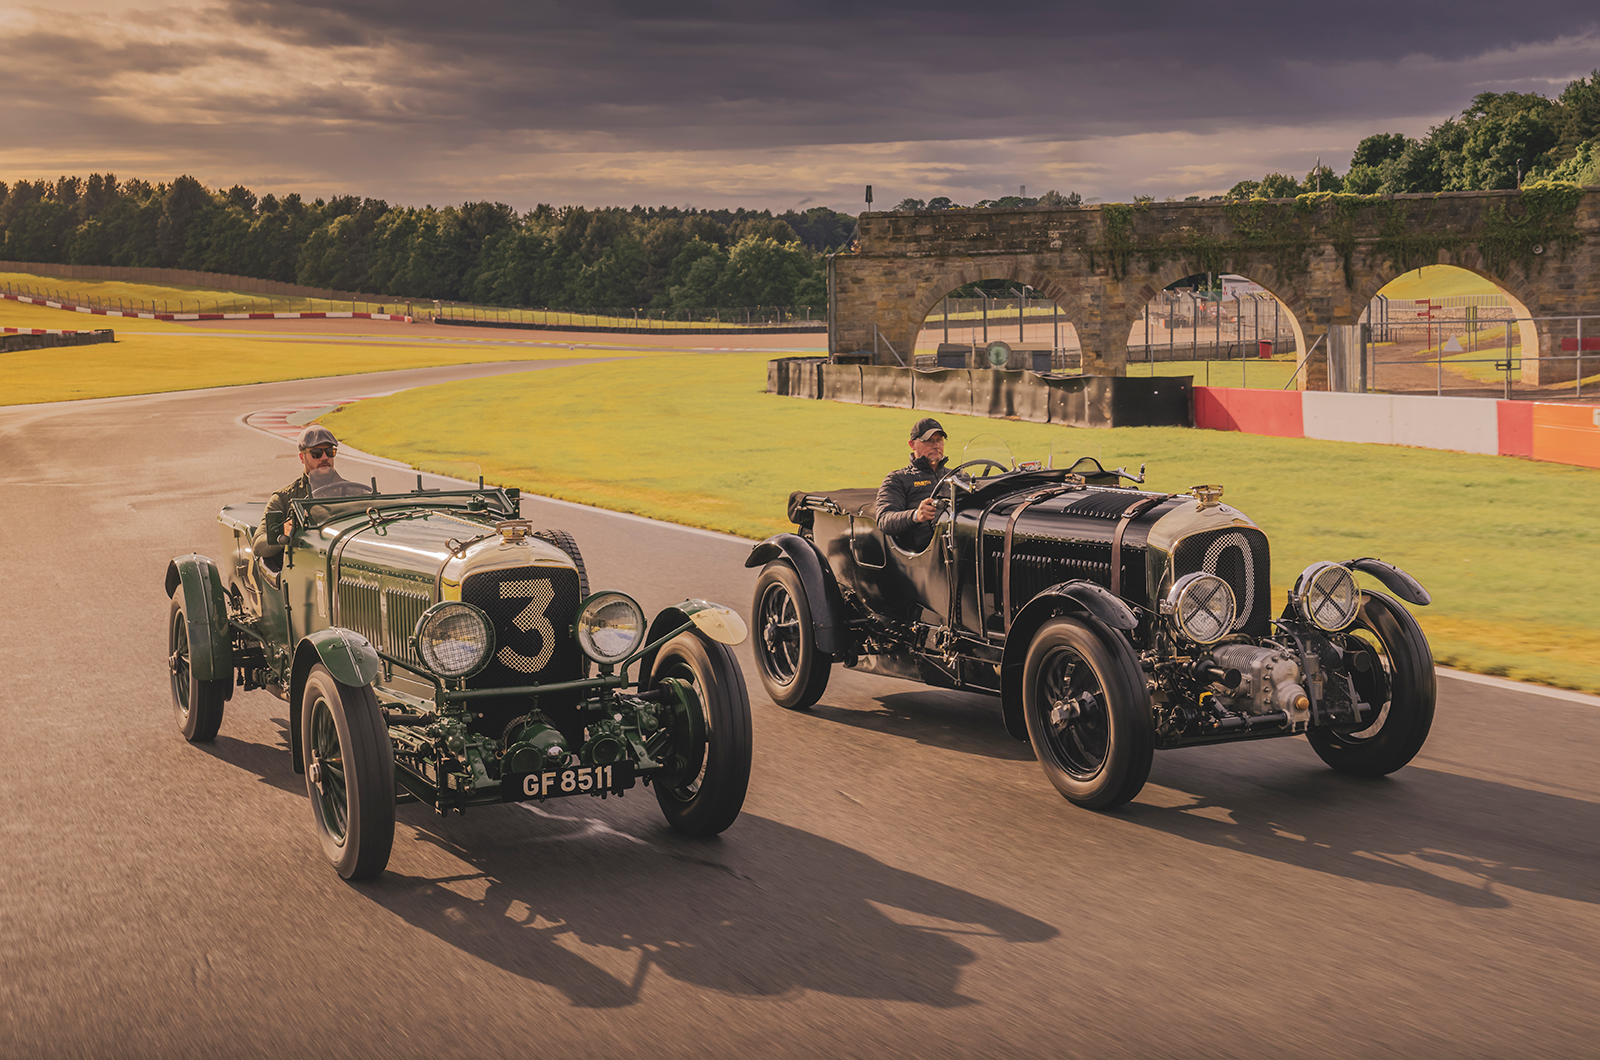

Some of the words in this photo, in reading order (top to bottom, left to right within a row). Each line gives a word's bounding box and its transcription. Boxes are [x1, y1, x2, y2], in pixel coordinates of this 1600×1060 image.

[497, 579, 555, 672] 3
[1202, 533, 1255, 630] 0
[523, 773, 556, 796] GF
[560, 765, 612, 792] 8511
